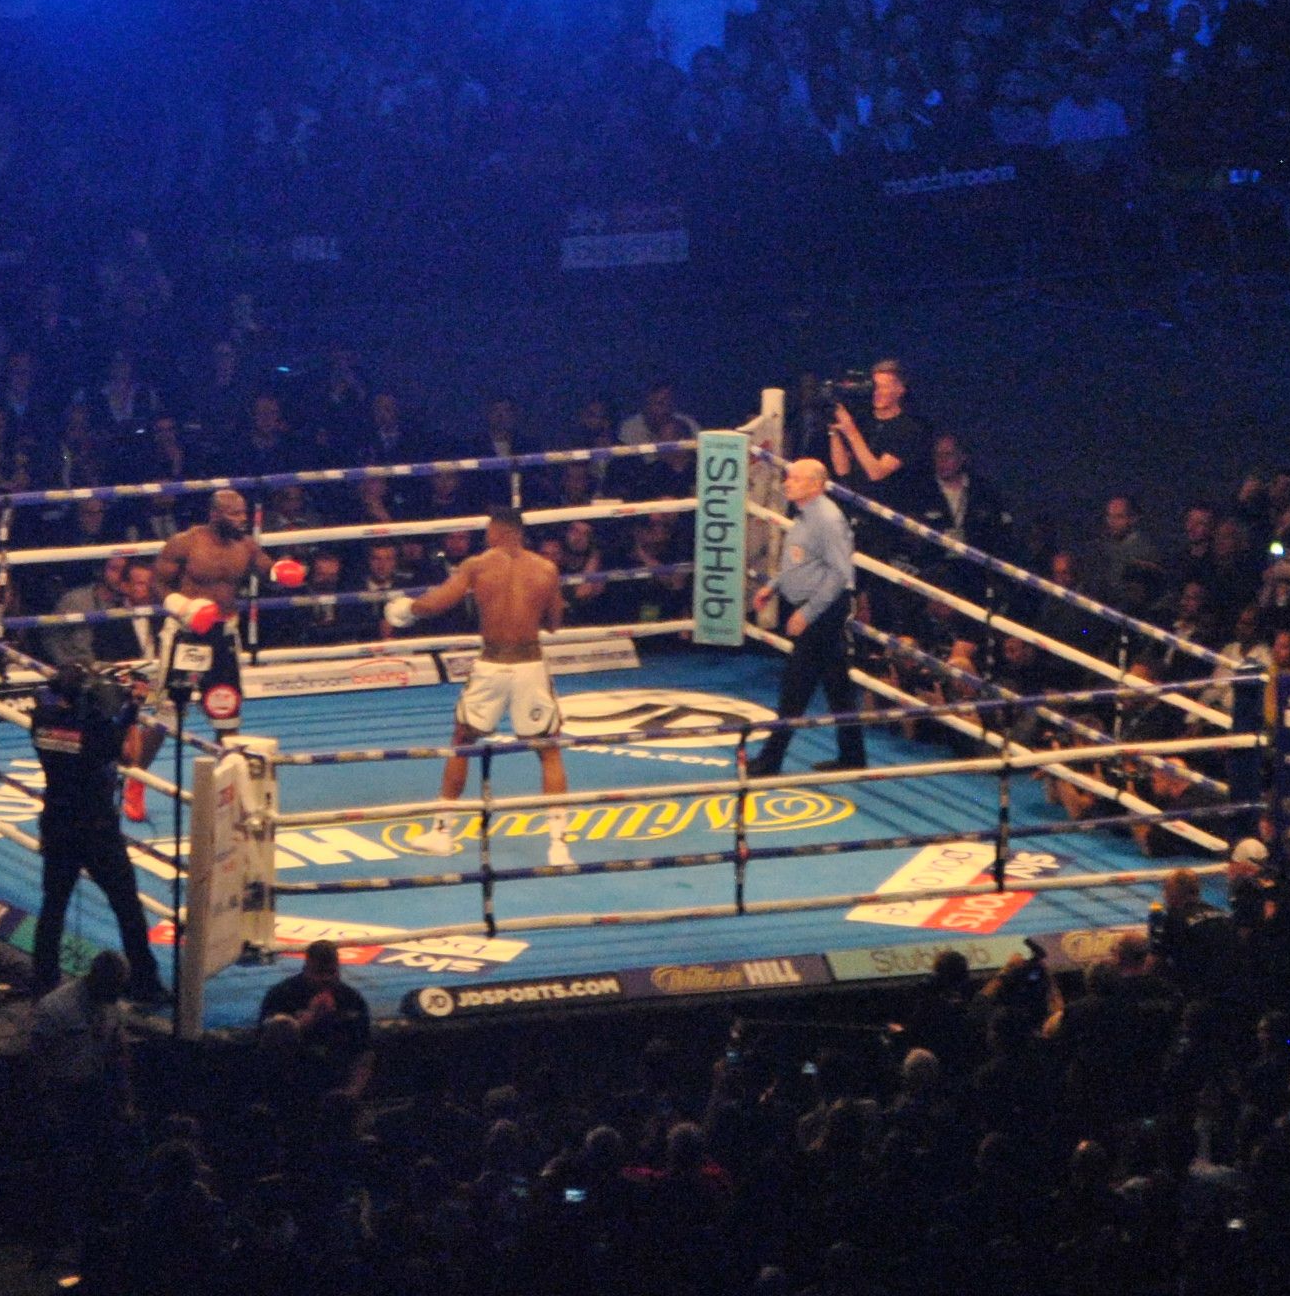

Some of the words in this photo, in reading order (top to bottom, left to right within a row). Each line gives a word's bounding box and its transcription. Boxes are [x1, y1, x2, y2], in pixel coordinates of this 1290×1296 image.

[700, 455, 740, 621] StubHub
[743, 959, 803, 986] HILL
[457, 978, 622, 1008] JDSPORTS.COM
